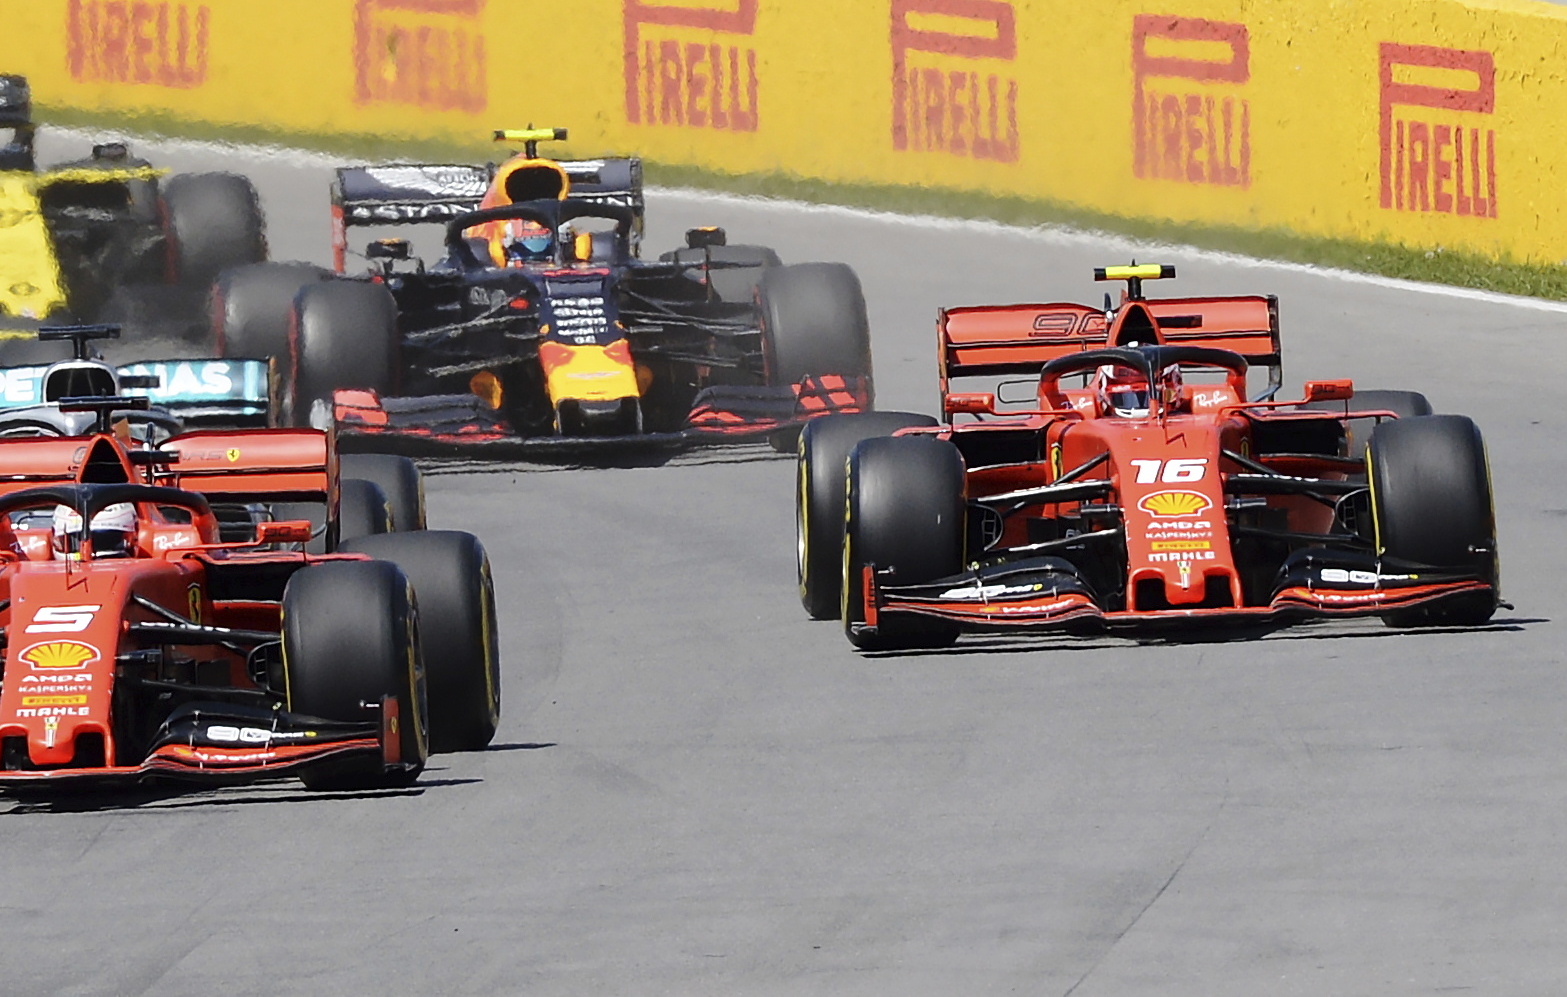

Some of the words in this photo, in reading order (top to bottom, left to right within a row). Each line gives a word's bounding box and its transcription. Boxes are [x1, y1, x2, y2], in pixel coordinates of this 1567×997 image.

[1133, 13, 1252, 190] PIRELLI
[1378, 42, 1499, 219] PIRELLI
[1130, 458, 1209, 484] 16
[1148, 551, 1215, 562] MAHLE
[24, 604, 103, 634] 5
[16, 707, 90, 717] MAHLE
